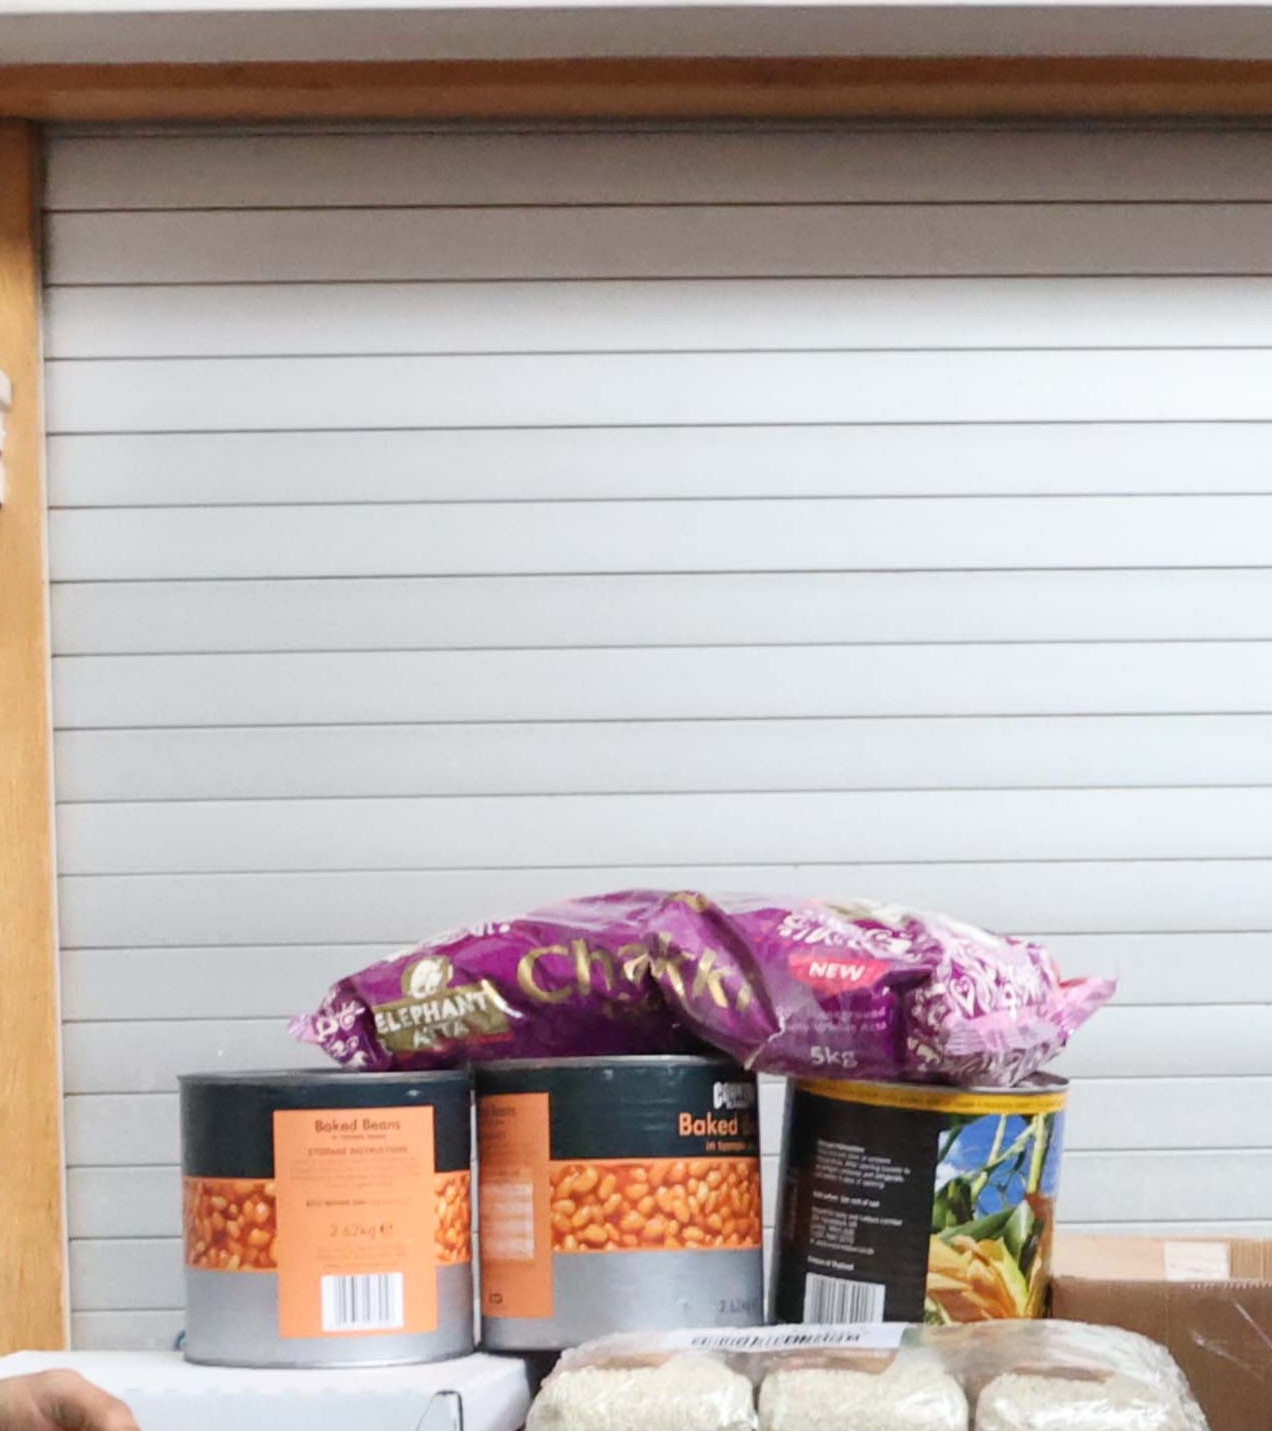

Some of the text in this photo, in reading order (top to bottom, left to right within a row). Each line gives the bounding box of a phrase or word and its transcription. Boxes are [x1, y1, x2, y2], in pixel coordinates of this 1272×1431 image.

[808, 961, 866, 981] NEW
[375, 992, 492, 1034] ELEPHANT
[810, 1045, 858, 1069] 5kg
[314, 1117, 402, 1134] Baked Beans
[678, 1111, 739, 1136] Baked
